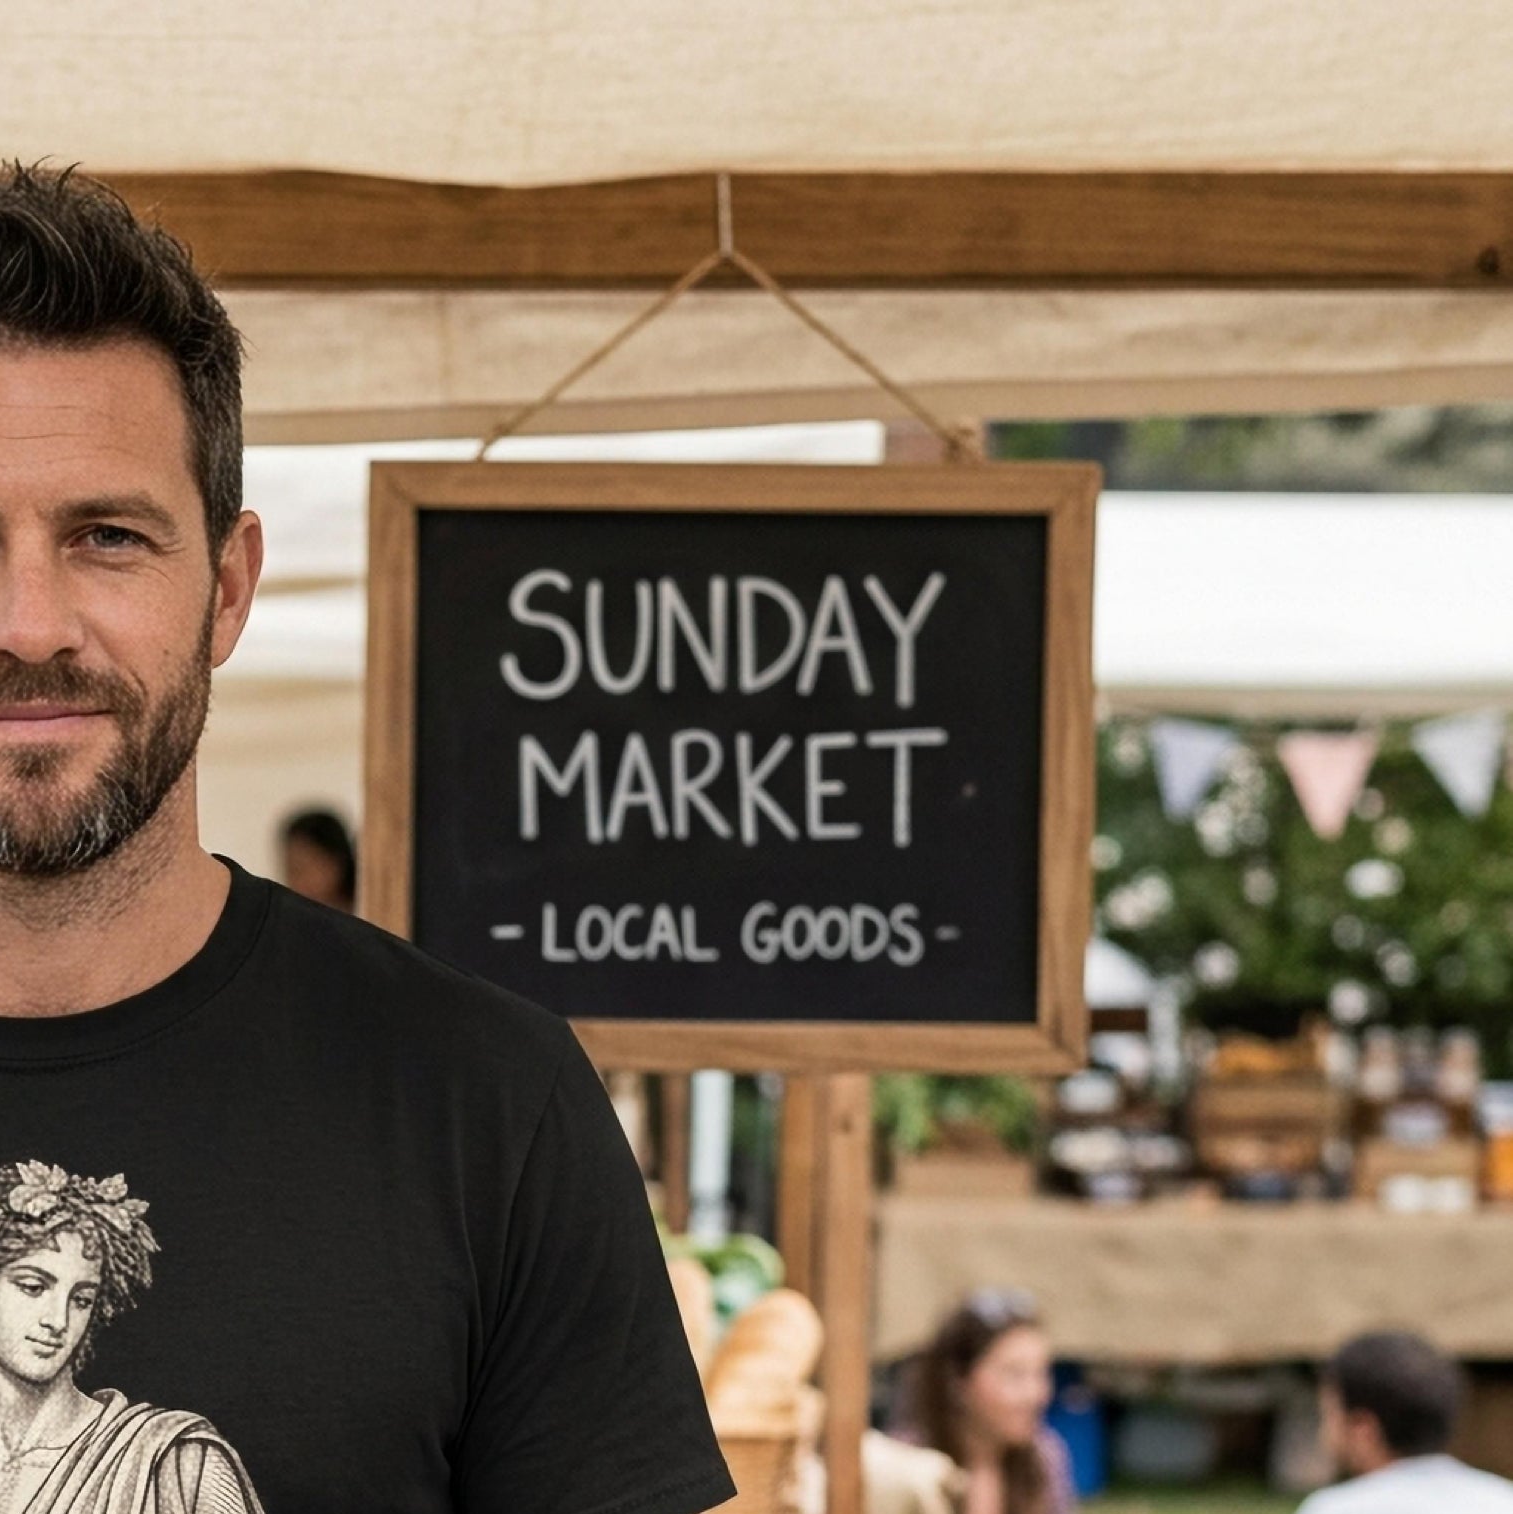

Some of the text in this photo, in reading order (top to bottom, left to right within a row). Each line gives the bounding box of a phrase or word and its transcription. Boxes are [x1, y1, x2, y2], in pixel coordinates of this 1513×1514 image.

[498, 567, 946, 709] SUNDAY
[517, 727, 950, 849] MARKET
[540, 901, 720, 964] LOCAL
[739, 900, 925, 968] GOODS
